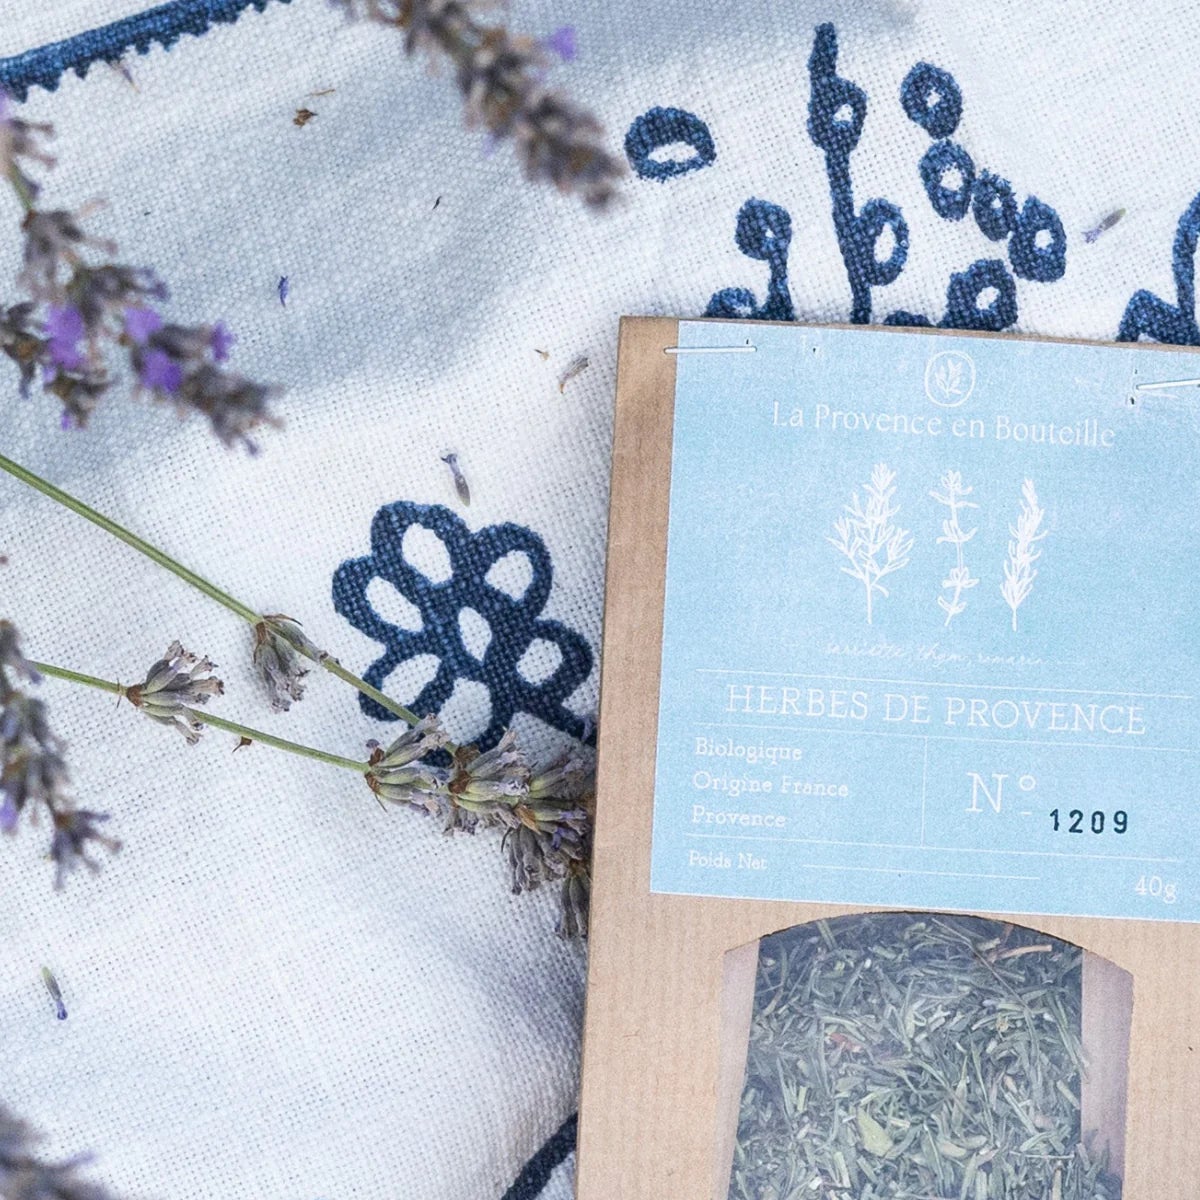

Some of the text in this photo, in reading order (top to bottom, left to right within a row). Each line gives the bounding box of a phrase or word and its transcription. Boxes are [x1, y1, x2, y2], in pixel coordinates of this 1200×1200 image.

[772, 400, 1115, 448] La Provence en Bouteille
[726, 684, 1147, 735] HERBES DE PROVENCE
[695, 737, 802, 763] Biologique
[693, 770, 849, 797] Origine France
[692, 806, 787, 828] Provence
[1049, 809, 1129, 833] 1209
[689, 850, 768, 871] Poids Net
[1134, 875, 1178, 902] 40g
